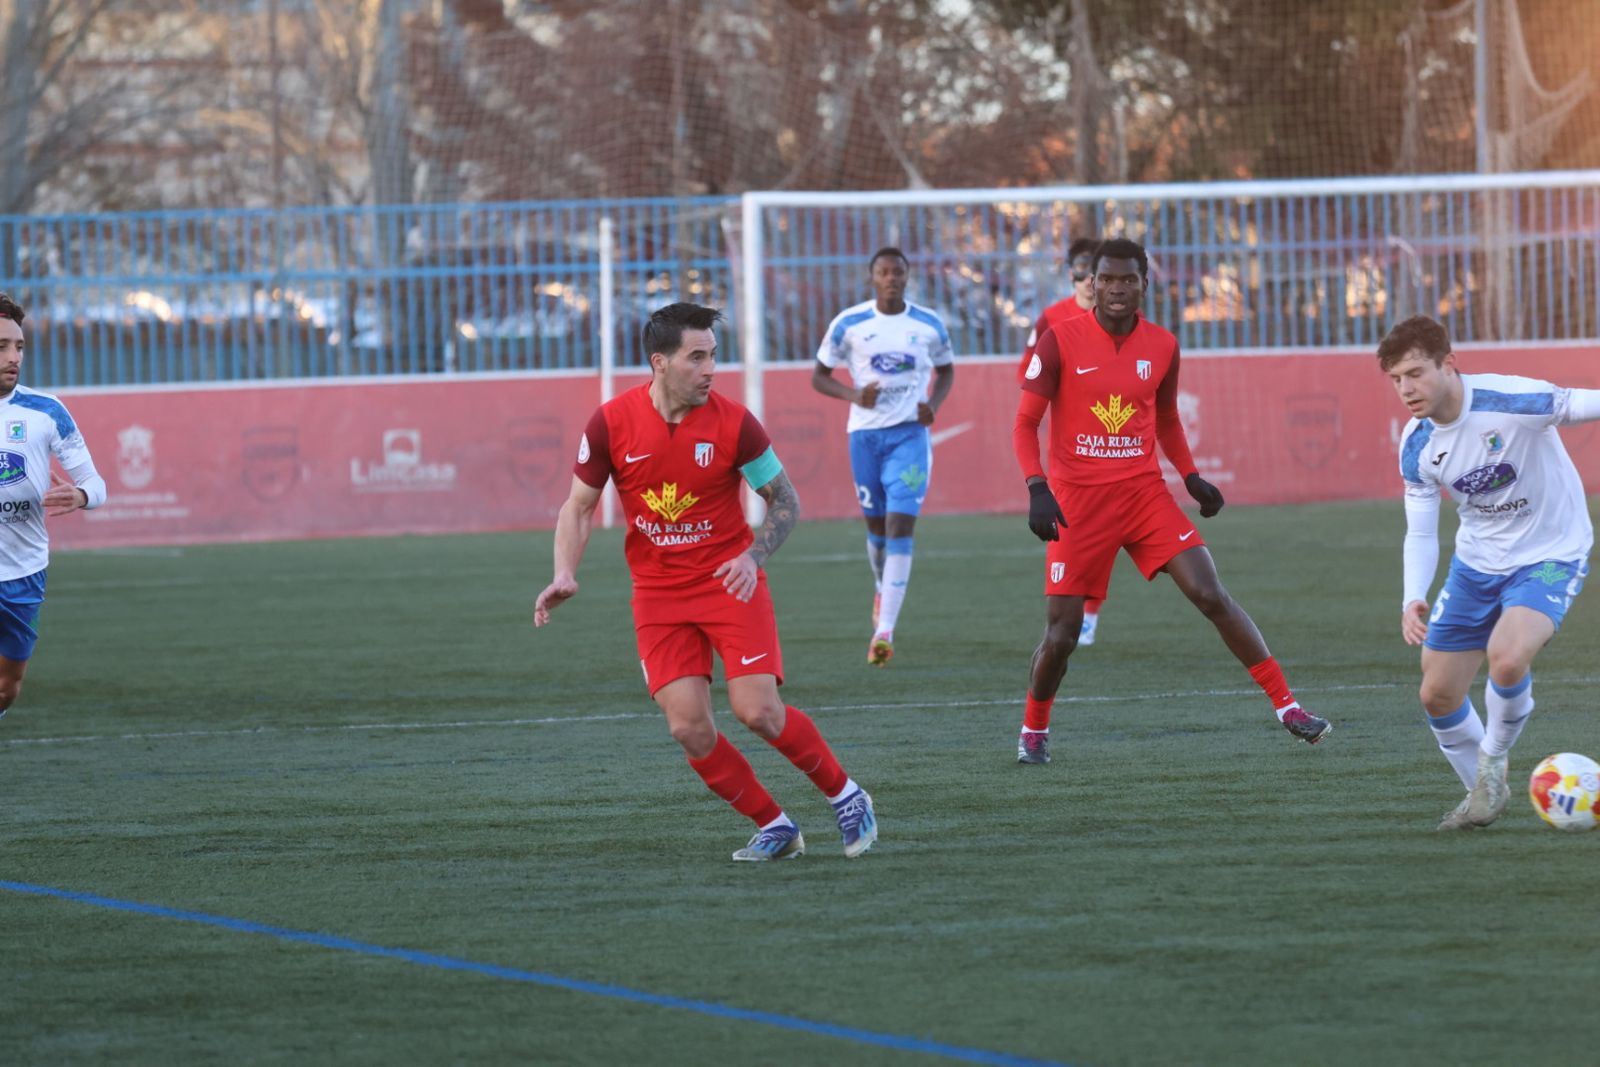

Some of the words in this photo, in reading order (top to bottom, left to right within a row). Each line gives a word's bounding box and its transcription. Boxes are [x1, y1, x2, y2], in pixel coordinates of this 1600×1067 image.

[1077, 434, 1105, 448] CAJA
[1108, 436, 1143, 447] RURAL
[1076, 446, 1088, 455] DE
[1089, 447, 1144, 458] SALAMANCA
[635, 515, 661, 534] CAJA
[664, 520, 712, 534] RURAL
[1430, 590, 1450, 623] 5
